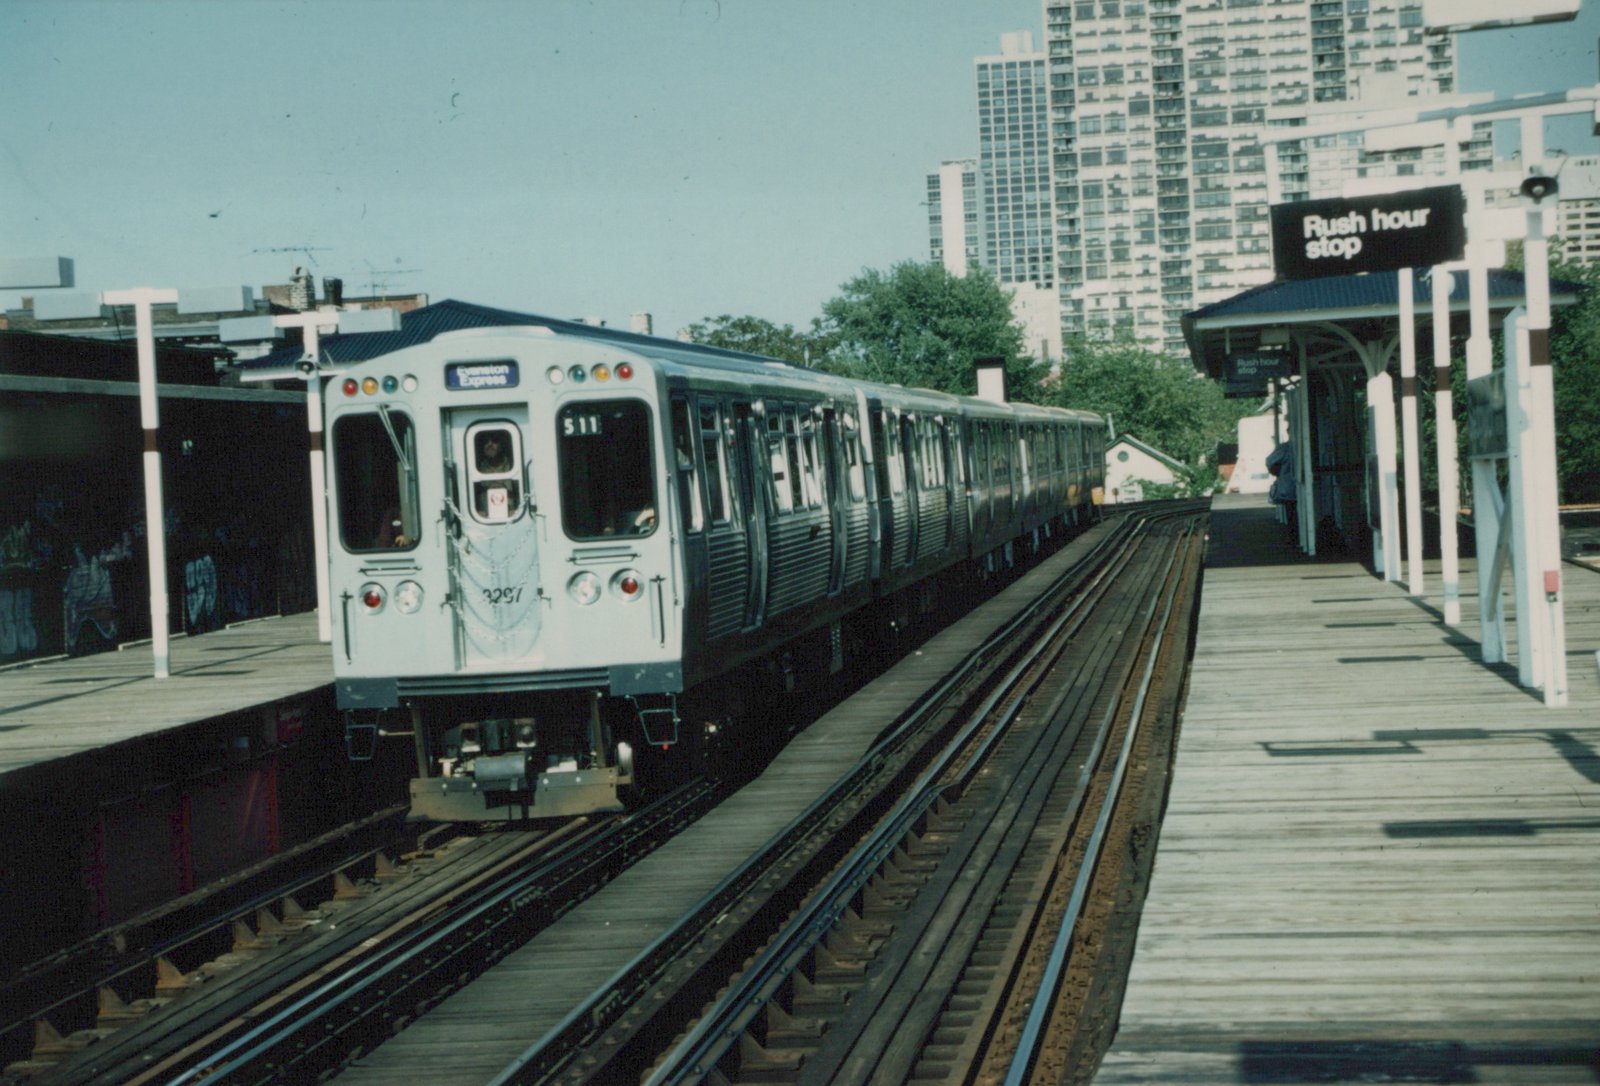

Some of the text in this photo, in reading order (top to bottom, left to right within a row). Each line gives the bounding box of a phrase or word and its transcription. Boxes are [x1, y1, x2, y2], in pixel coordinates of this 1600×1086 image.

[1303, 208, 1431, 239] Rush hour
[1305, 236, 1362, 260] stop
[1237, 358, 1280, 367] Rush hour
[1238, 367, 1257, 375] stop
[459, 374, 508, 388] Express
[564, 416, 598, 435] 511
